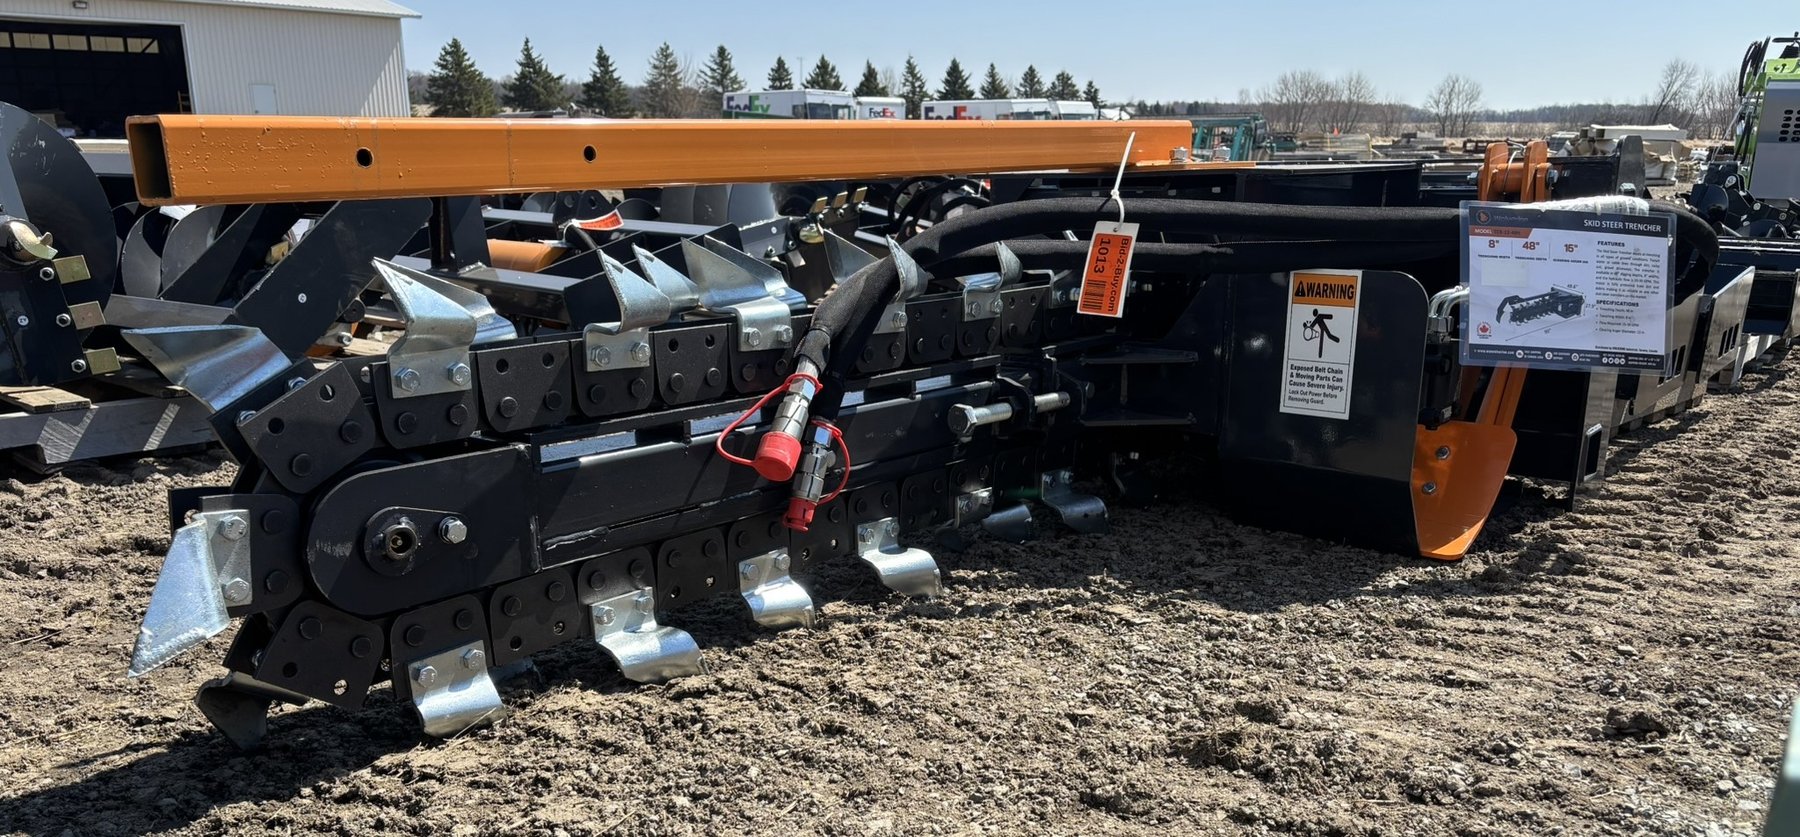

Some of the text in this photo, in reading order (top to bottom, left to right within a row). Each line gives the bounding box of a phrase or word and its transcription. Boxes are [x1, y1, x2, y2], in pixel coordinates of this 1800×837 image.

[869, 107, 896, 118] FedEx
[1602, 220, 1624, 229] STEER
[1624, 222, 1662, 232] TRENCHER
[1488, 240, 1500, 248] 8"
[1522, 241, 1540, 250] 48"
[1094, 238, 1111, 274] 1013
[1107, 238, 1130, 312] Bid-2-Buy.com
[1306, 282, 1354, 300] WARNING
[1290, 364, 1314, 372] Exposed
[1314, 365, 1326, 373] Belt
[1296, 372, 1314, 381] Moving
[1327, 384, 1344, 392] Injury.
[1288, 396, 1310, 404] Removing
